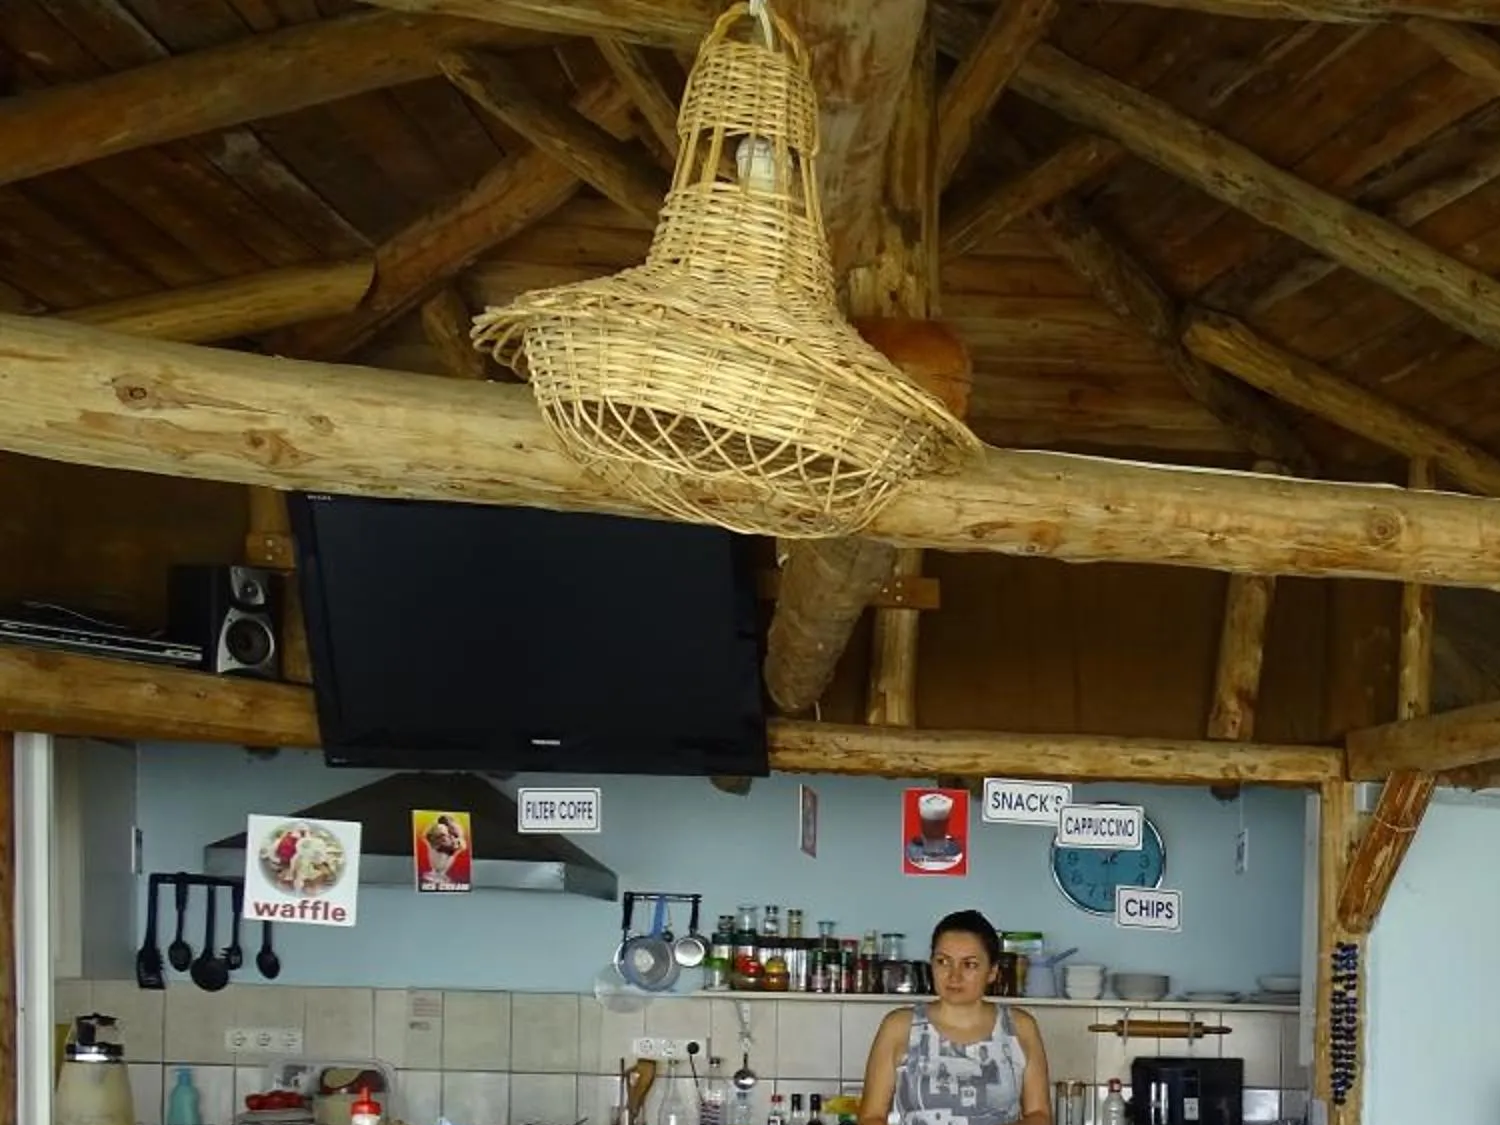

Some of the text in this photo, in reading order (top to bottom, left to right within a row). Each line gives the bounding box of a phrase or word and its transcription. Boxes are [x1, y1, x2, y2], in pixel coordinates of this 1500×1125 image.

[526, 801, 593, 820] FILTER COFFE
[991, 790, 1063, 813] SNACK'S
[1065, 816, 1135, 837] CAPPUCCINO
[253, 899, 347, 921] waffle
[1125, 899, 1175, 919] CHIPS
